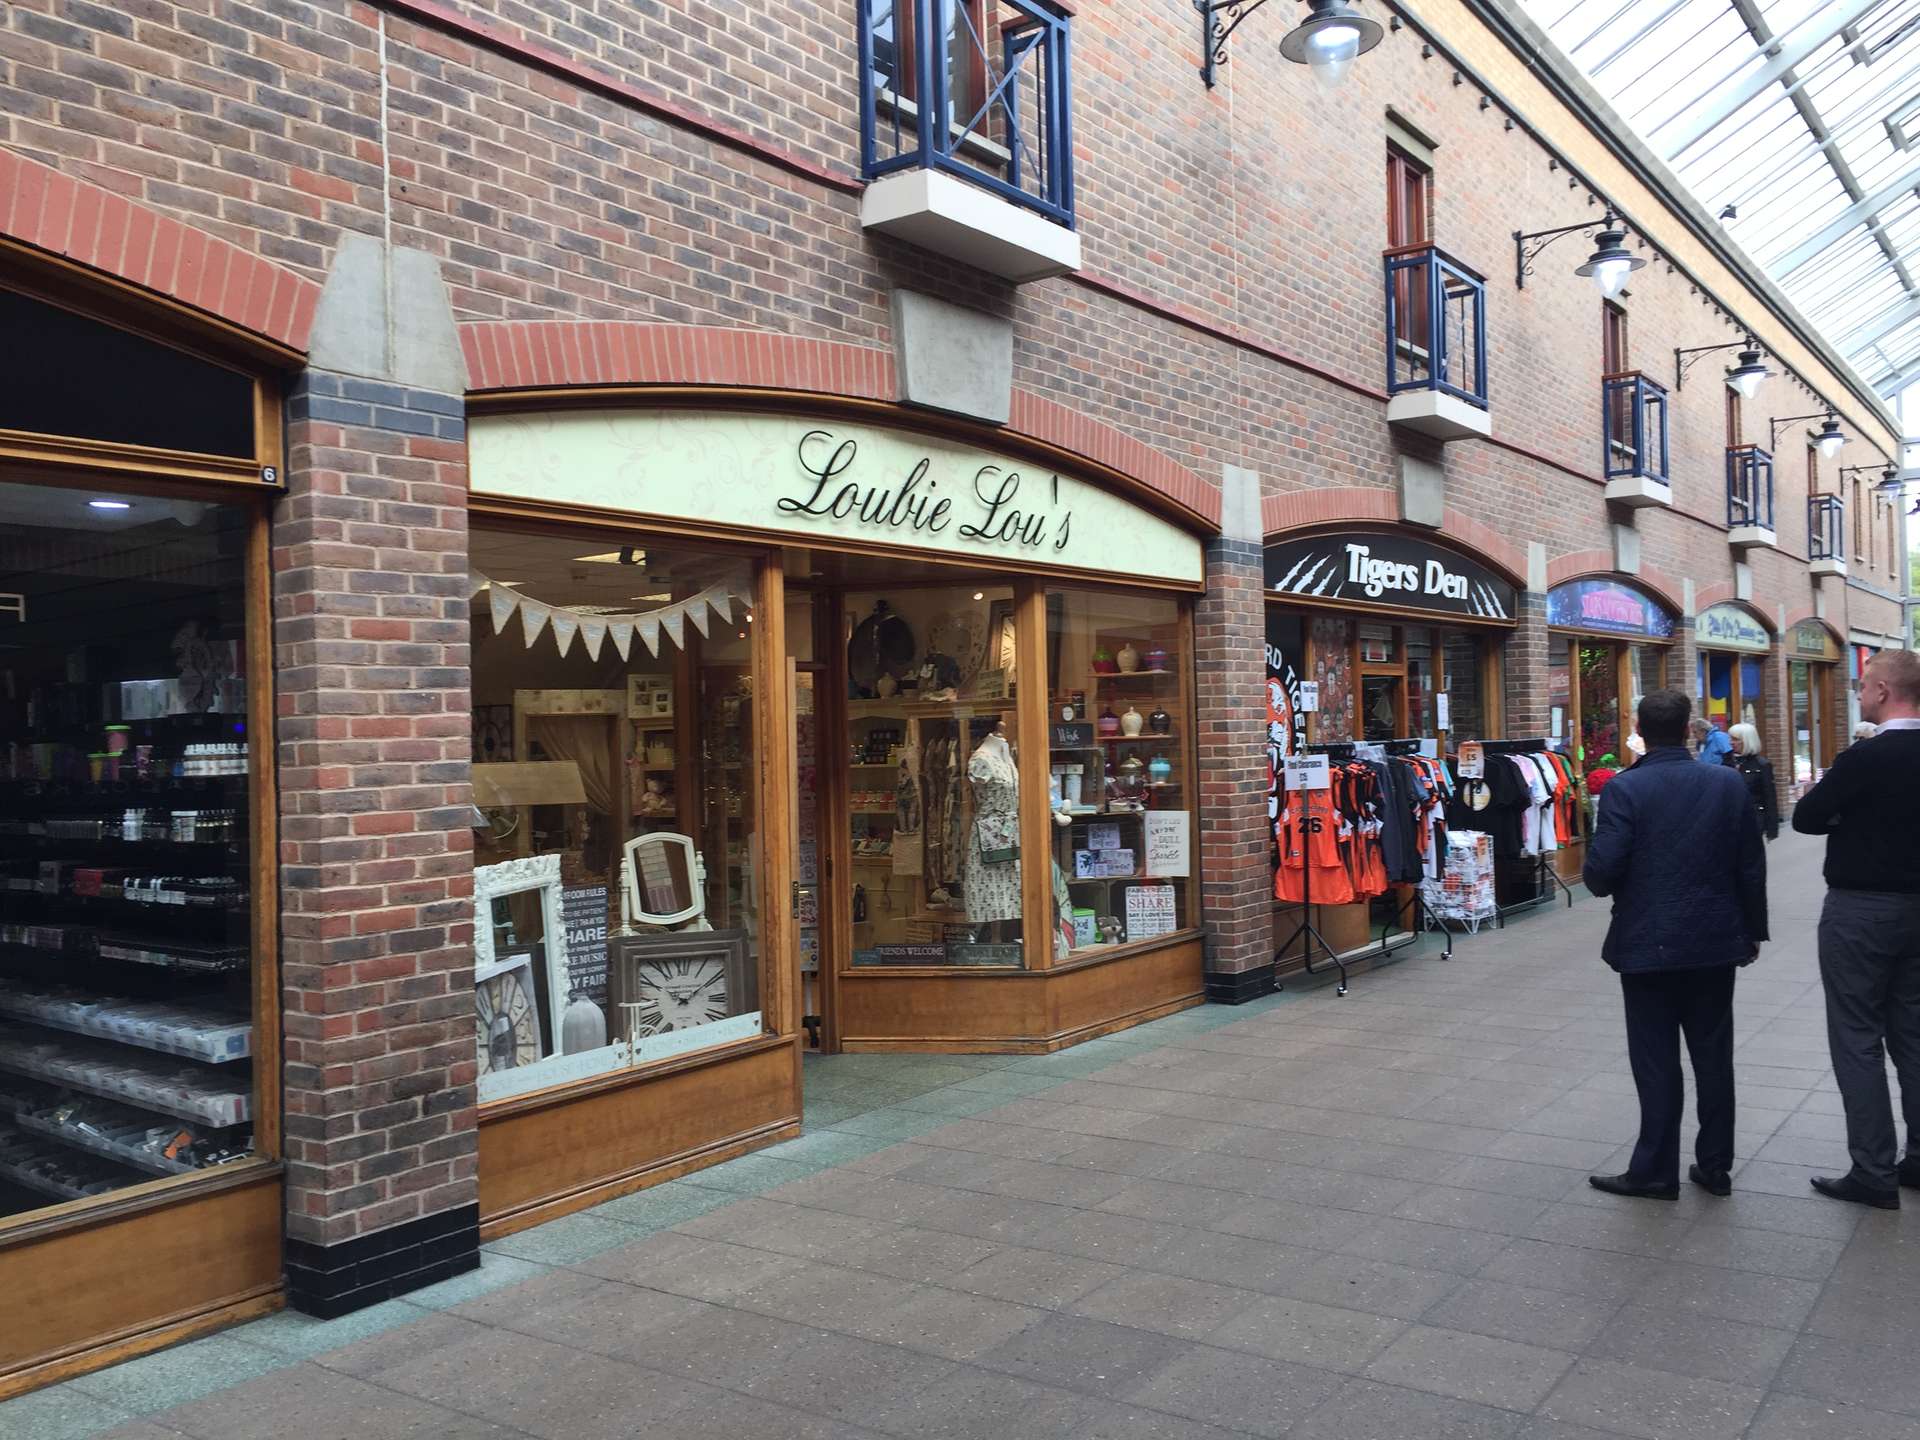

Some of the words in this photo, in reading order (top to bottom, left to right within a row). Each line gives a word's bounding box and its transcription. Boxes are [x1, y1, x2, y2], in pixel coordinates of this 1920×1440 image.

[263, 467, 275, 481] 6
[778, 430, 952, 533] Loubie
[959, 464, 1073, 551] Lou's
[1345, 543, 1419, 597] Tigers
[1424, 559, 1469, 600] Den
[1285, 665, 1306, 756] TIGER
[1129, 897, 1173, 909] SHARE
[582, 973, 607, 988] FAIR
